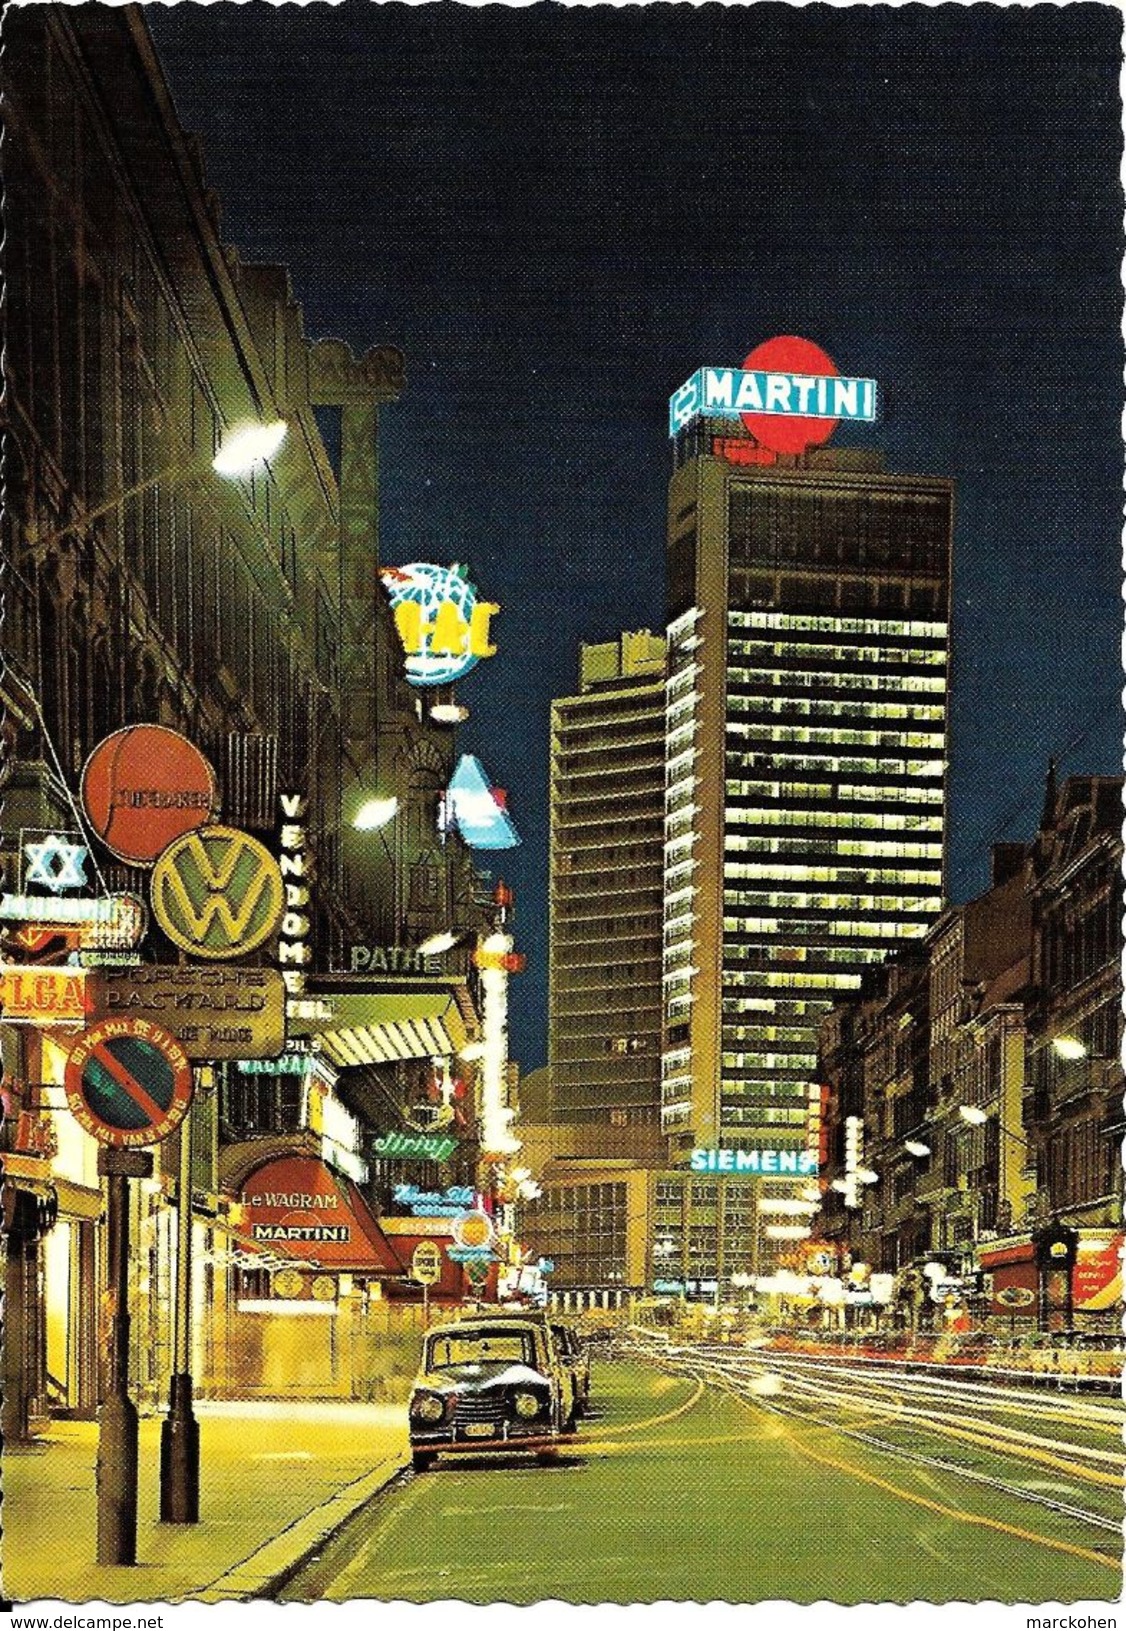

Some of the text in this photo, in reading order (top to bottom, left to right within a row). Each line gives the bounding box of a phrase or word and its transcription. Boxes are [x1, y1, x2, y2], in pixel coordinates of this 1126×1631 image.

[705, 370, 873, 416] MARTINI
[278, 794, 311, 993] VENDOME
[105, 967, 267, 987] PORSCHE
[106, 991, 269, 1011] PACKARD
[690, 1148, 814, 1173] SIEMENS
[241, 1191, 338, 1210] Le WAGRAM
[255, 1225, 348, 1242] MARTINI
